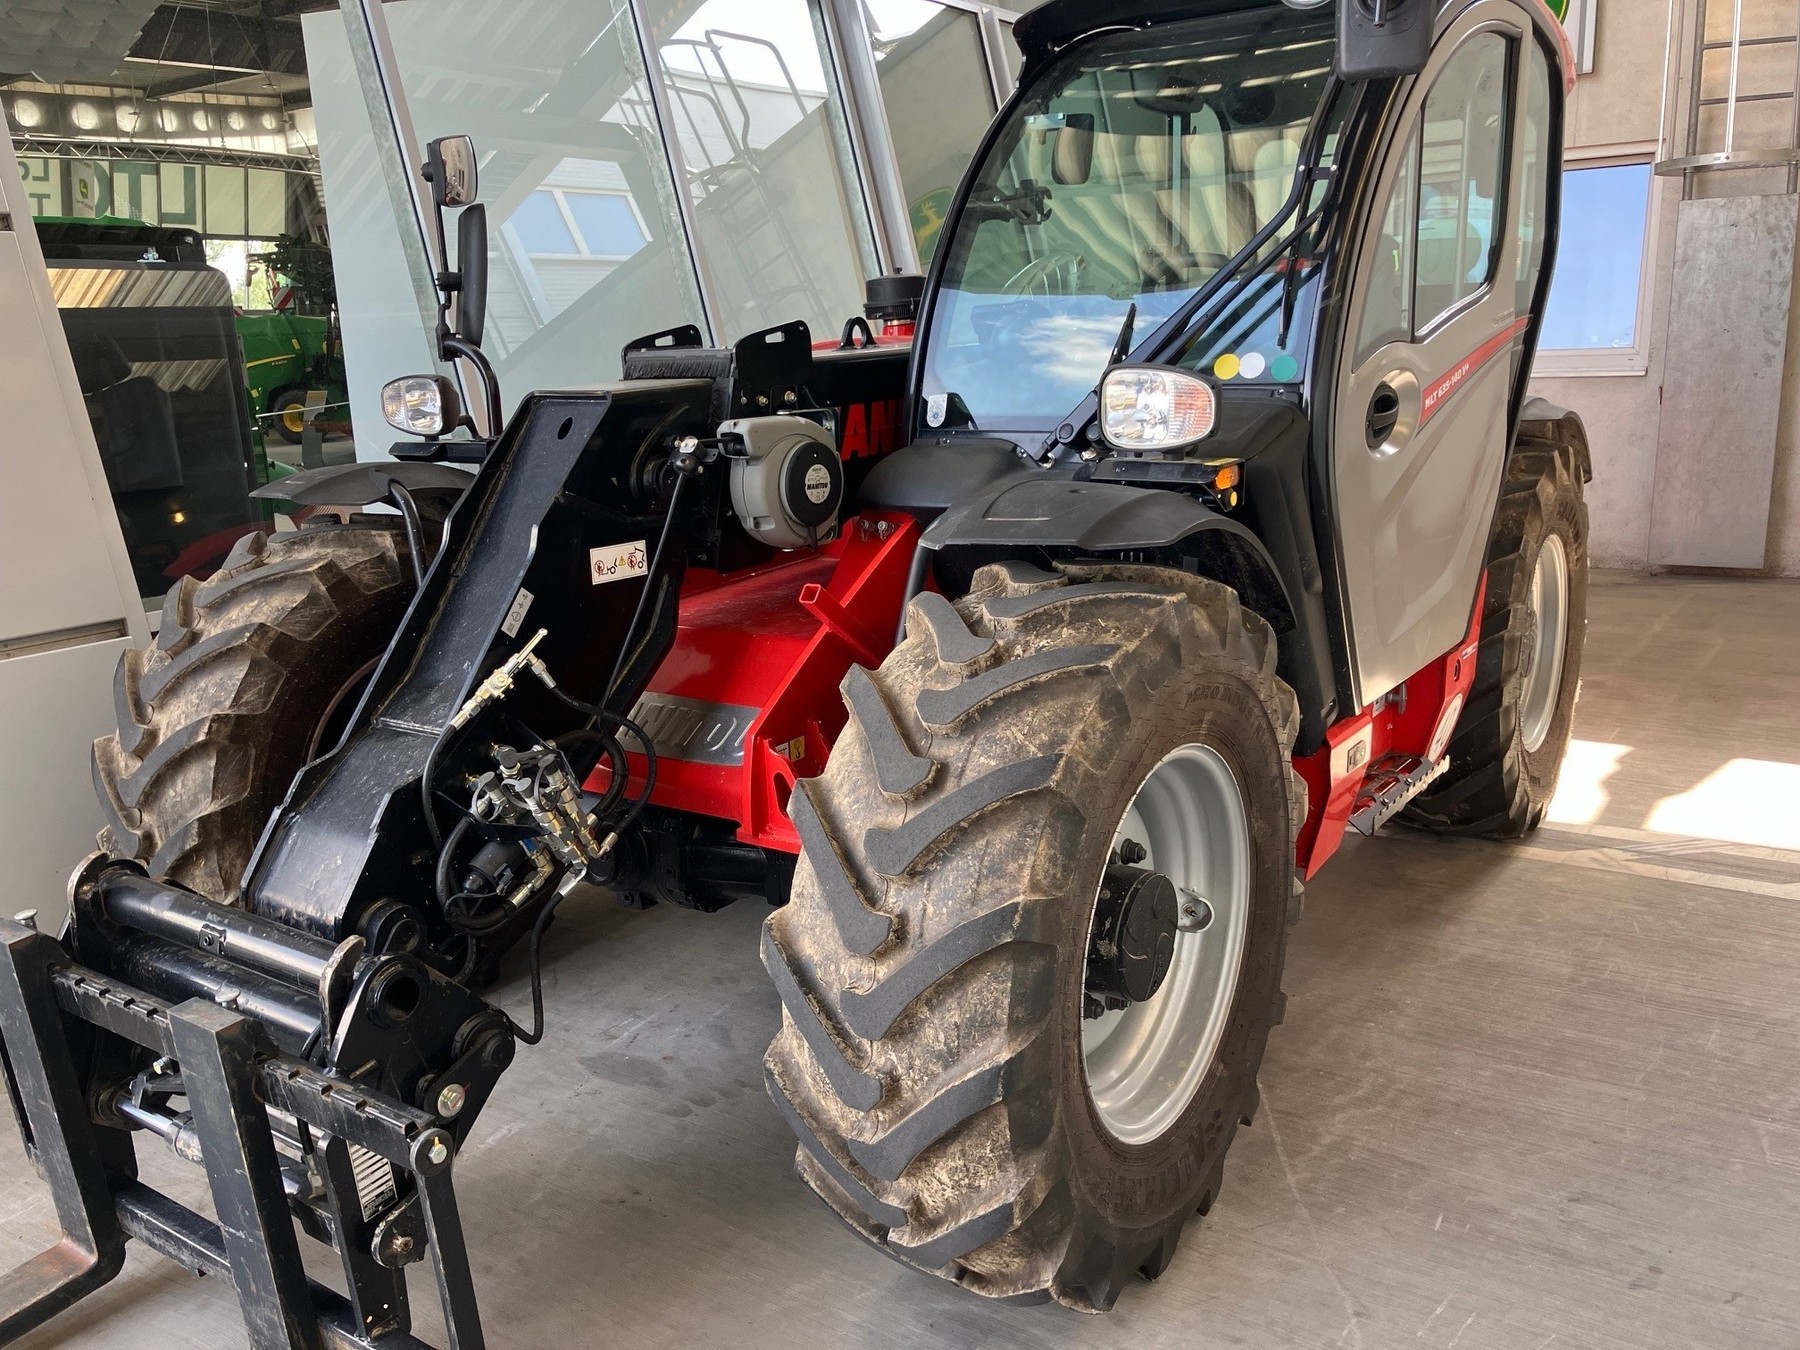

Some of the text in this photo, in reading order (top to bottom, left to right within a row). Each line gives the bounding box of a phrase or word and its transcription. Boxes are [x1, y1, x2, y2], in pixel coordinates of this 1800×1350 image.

[1425, 390, 1438, 410] MLT
[1438, 368, 1461, 397] 635-140
[807, 482, 829, 490] MANITOU
